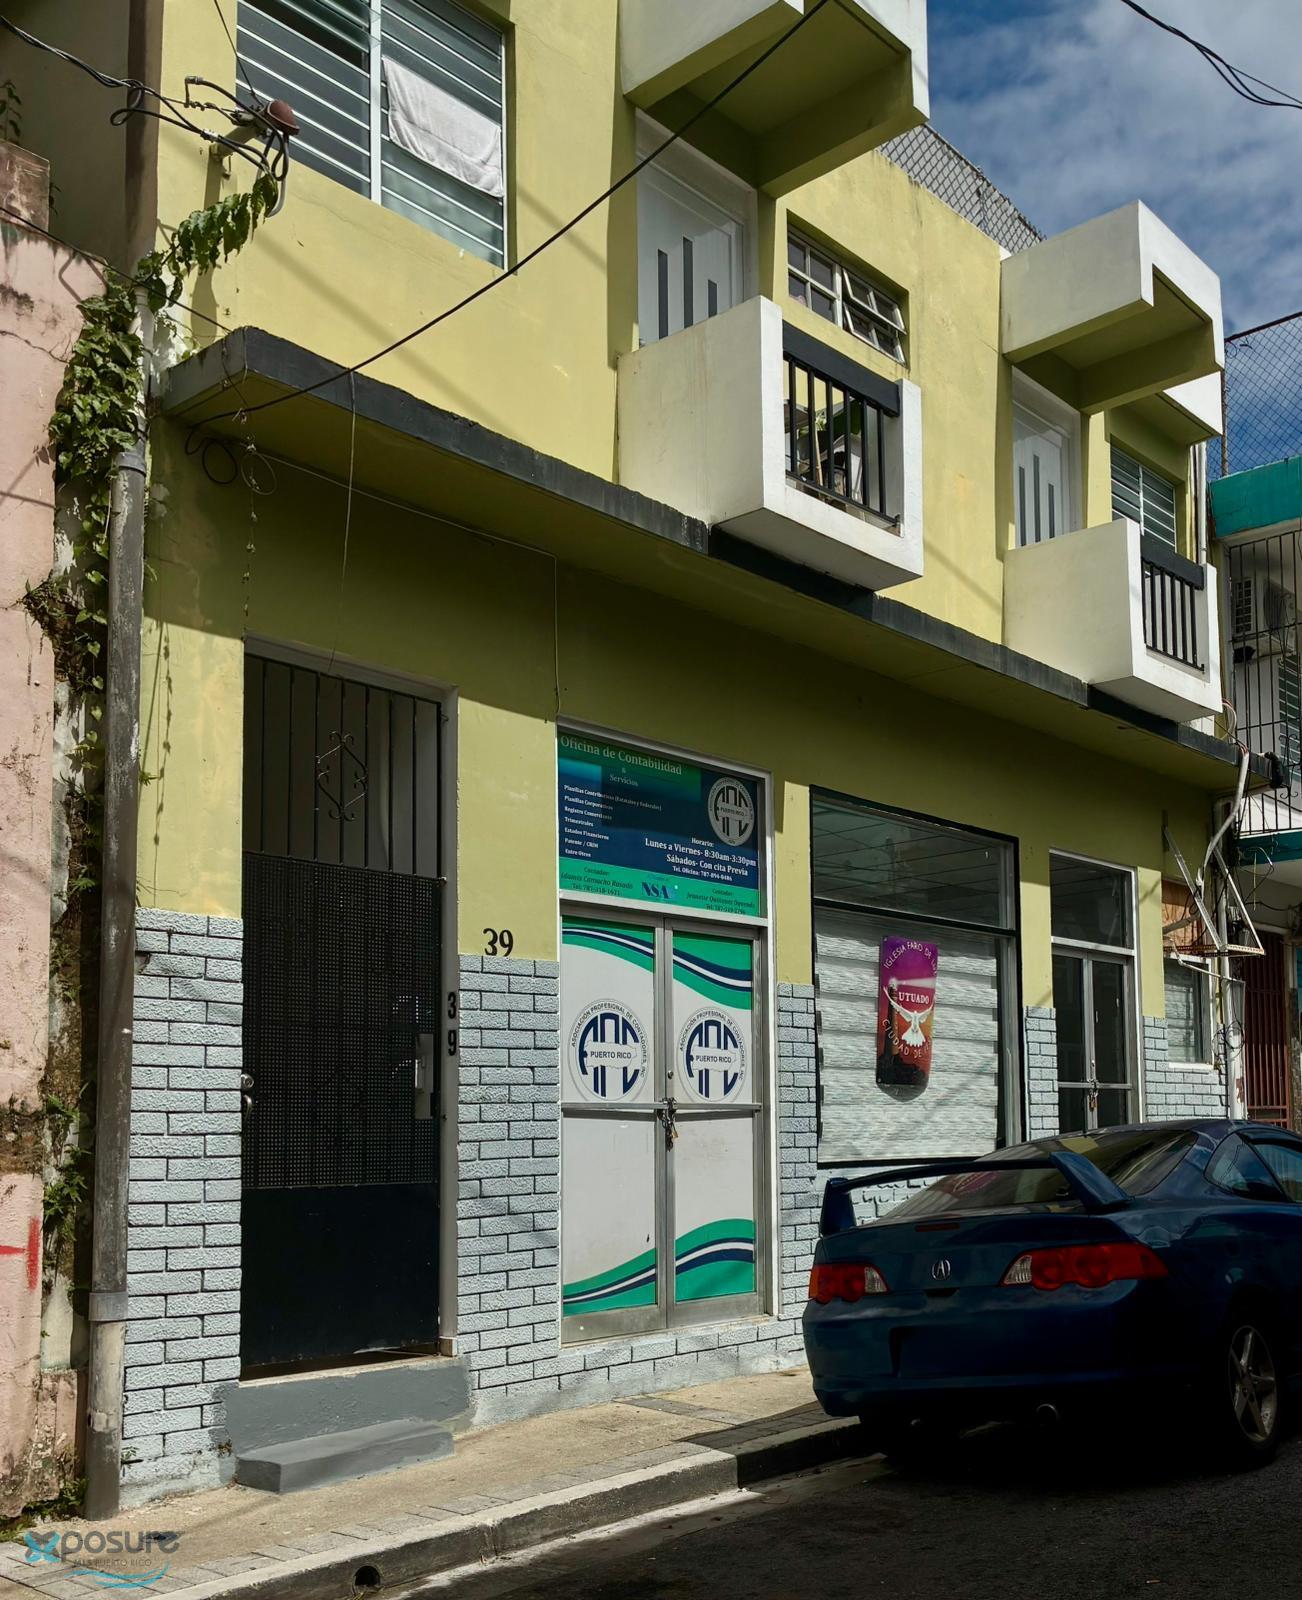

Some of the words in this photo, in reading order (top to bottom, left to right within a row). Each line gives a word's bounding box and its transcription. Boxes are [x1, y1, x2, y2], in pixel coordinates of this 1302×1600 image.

[560, 735, 600, 755] Oficina
[603, 746, 616, 758] de
[618, 750, 682, 775] Contabilidad
[609, 774, 639, 787] Servicios
[691, 837, 714, 848] Horario:
[645, 838, 667, 850] Lunes
[704, 849, 757, 867] 8:30am-3:30pm
[700, 860, 713, 869] Con
[714, 862, 726, 872] cita
[727, 865, 748, 876] Previa
[483, 928, 513, 957] 39
[883, 944, 907, 969] IGLESIA
[906, 941, 923, 952] FARO
[898, 991, 930, 1004] UTUADO
[590, 1002, 626, 1014] PROFESIONAL
[625, 1011, 633, 1020] DE
[882, 1019, 909, 1056] CIUDAD
[590, 1050, 616, 1059] PUERTO
